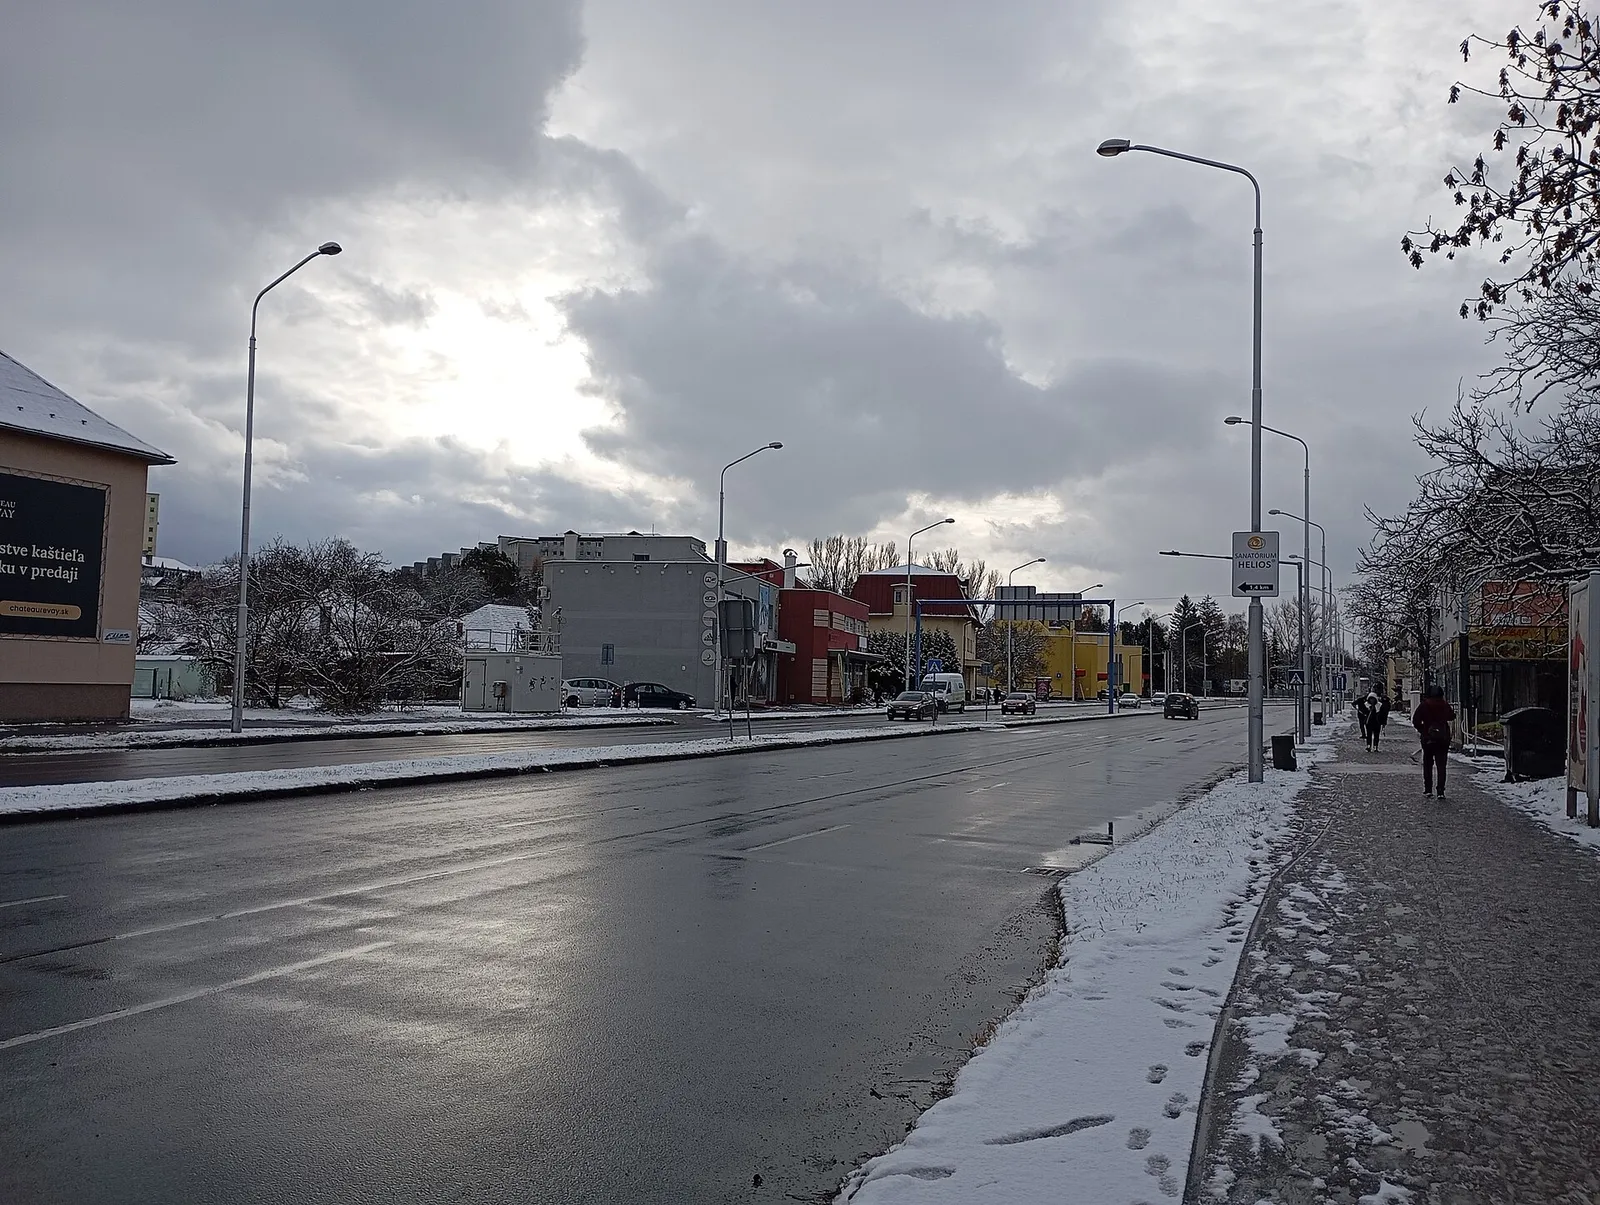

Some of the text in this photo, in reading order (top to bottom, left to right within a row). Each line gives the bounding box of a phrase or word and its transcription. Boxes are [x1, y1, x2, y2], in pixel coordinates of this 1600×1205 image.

[0, 543, 85, 563] stve kaštieľa
[1238, 560, 1272, 569] HELIOS
[19, 565, 28, 575] v
[31, 565, 79, 583] predaji
[9, 605, 69, 616] chateaurevay.sk
